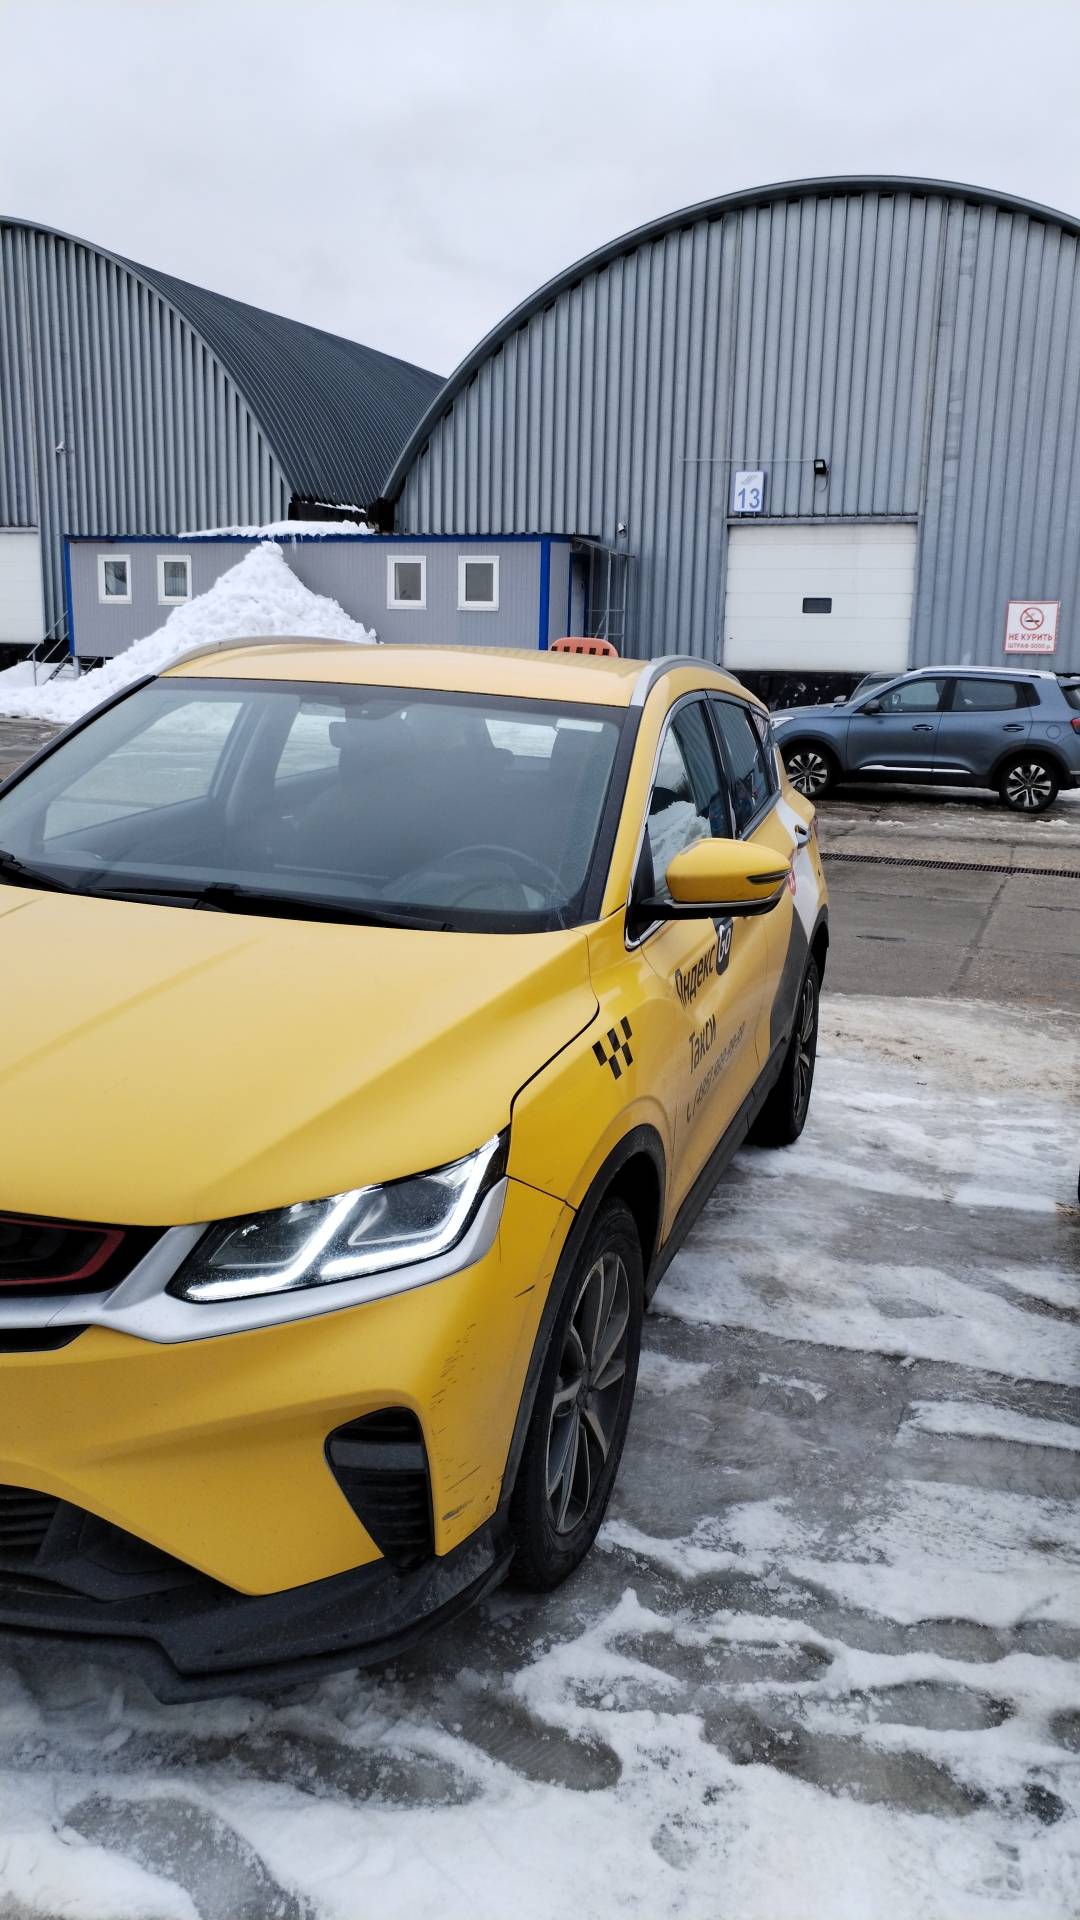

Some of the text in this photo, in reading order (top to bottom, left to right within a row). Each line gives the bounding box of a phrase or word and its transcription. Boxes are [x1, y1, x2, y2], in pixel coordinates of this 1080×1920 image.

[737, 487, 761, 509] 13
[1008, 633, 1053, 641] НЕ КУРИТЬ
[674, 923, 733, 1009] Яндекс Go
[688, 1012, 717, 1075] Такси
